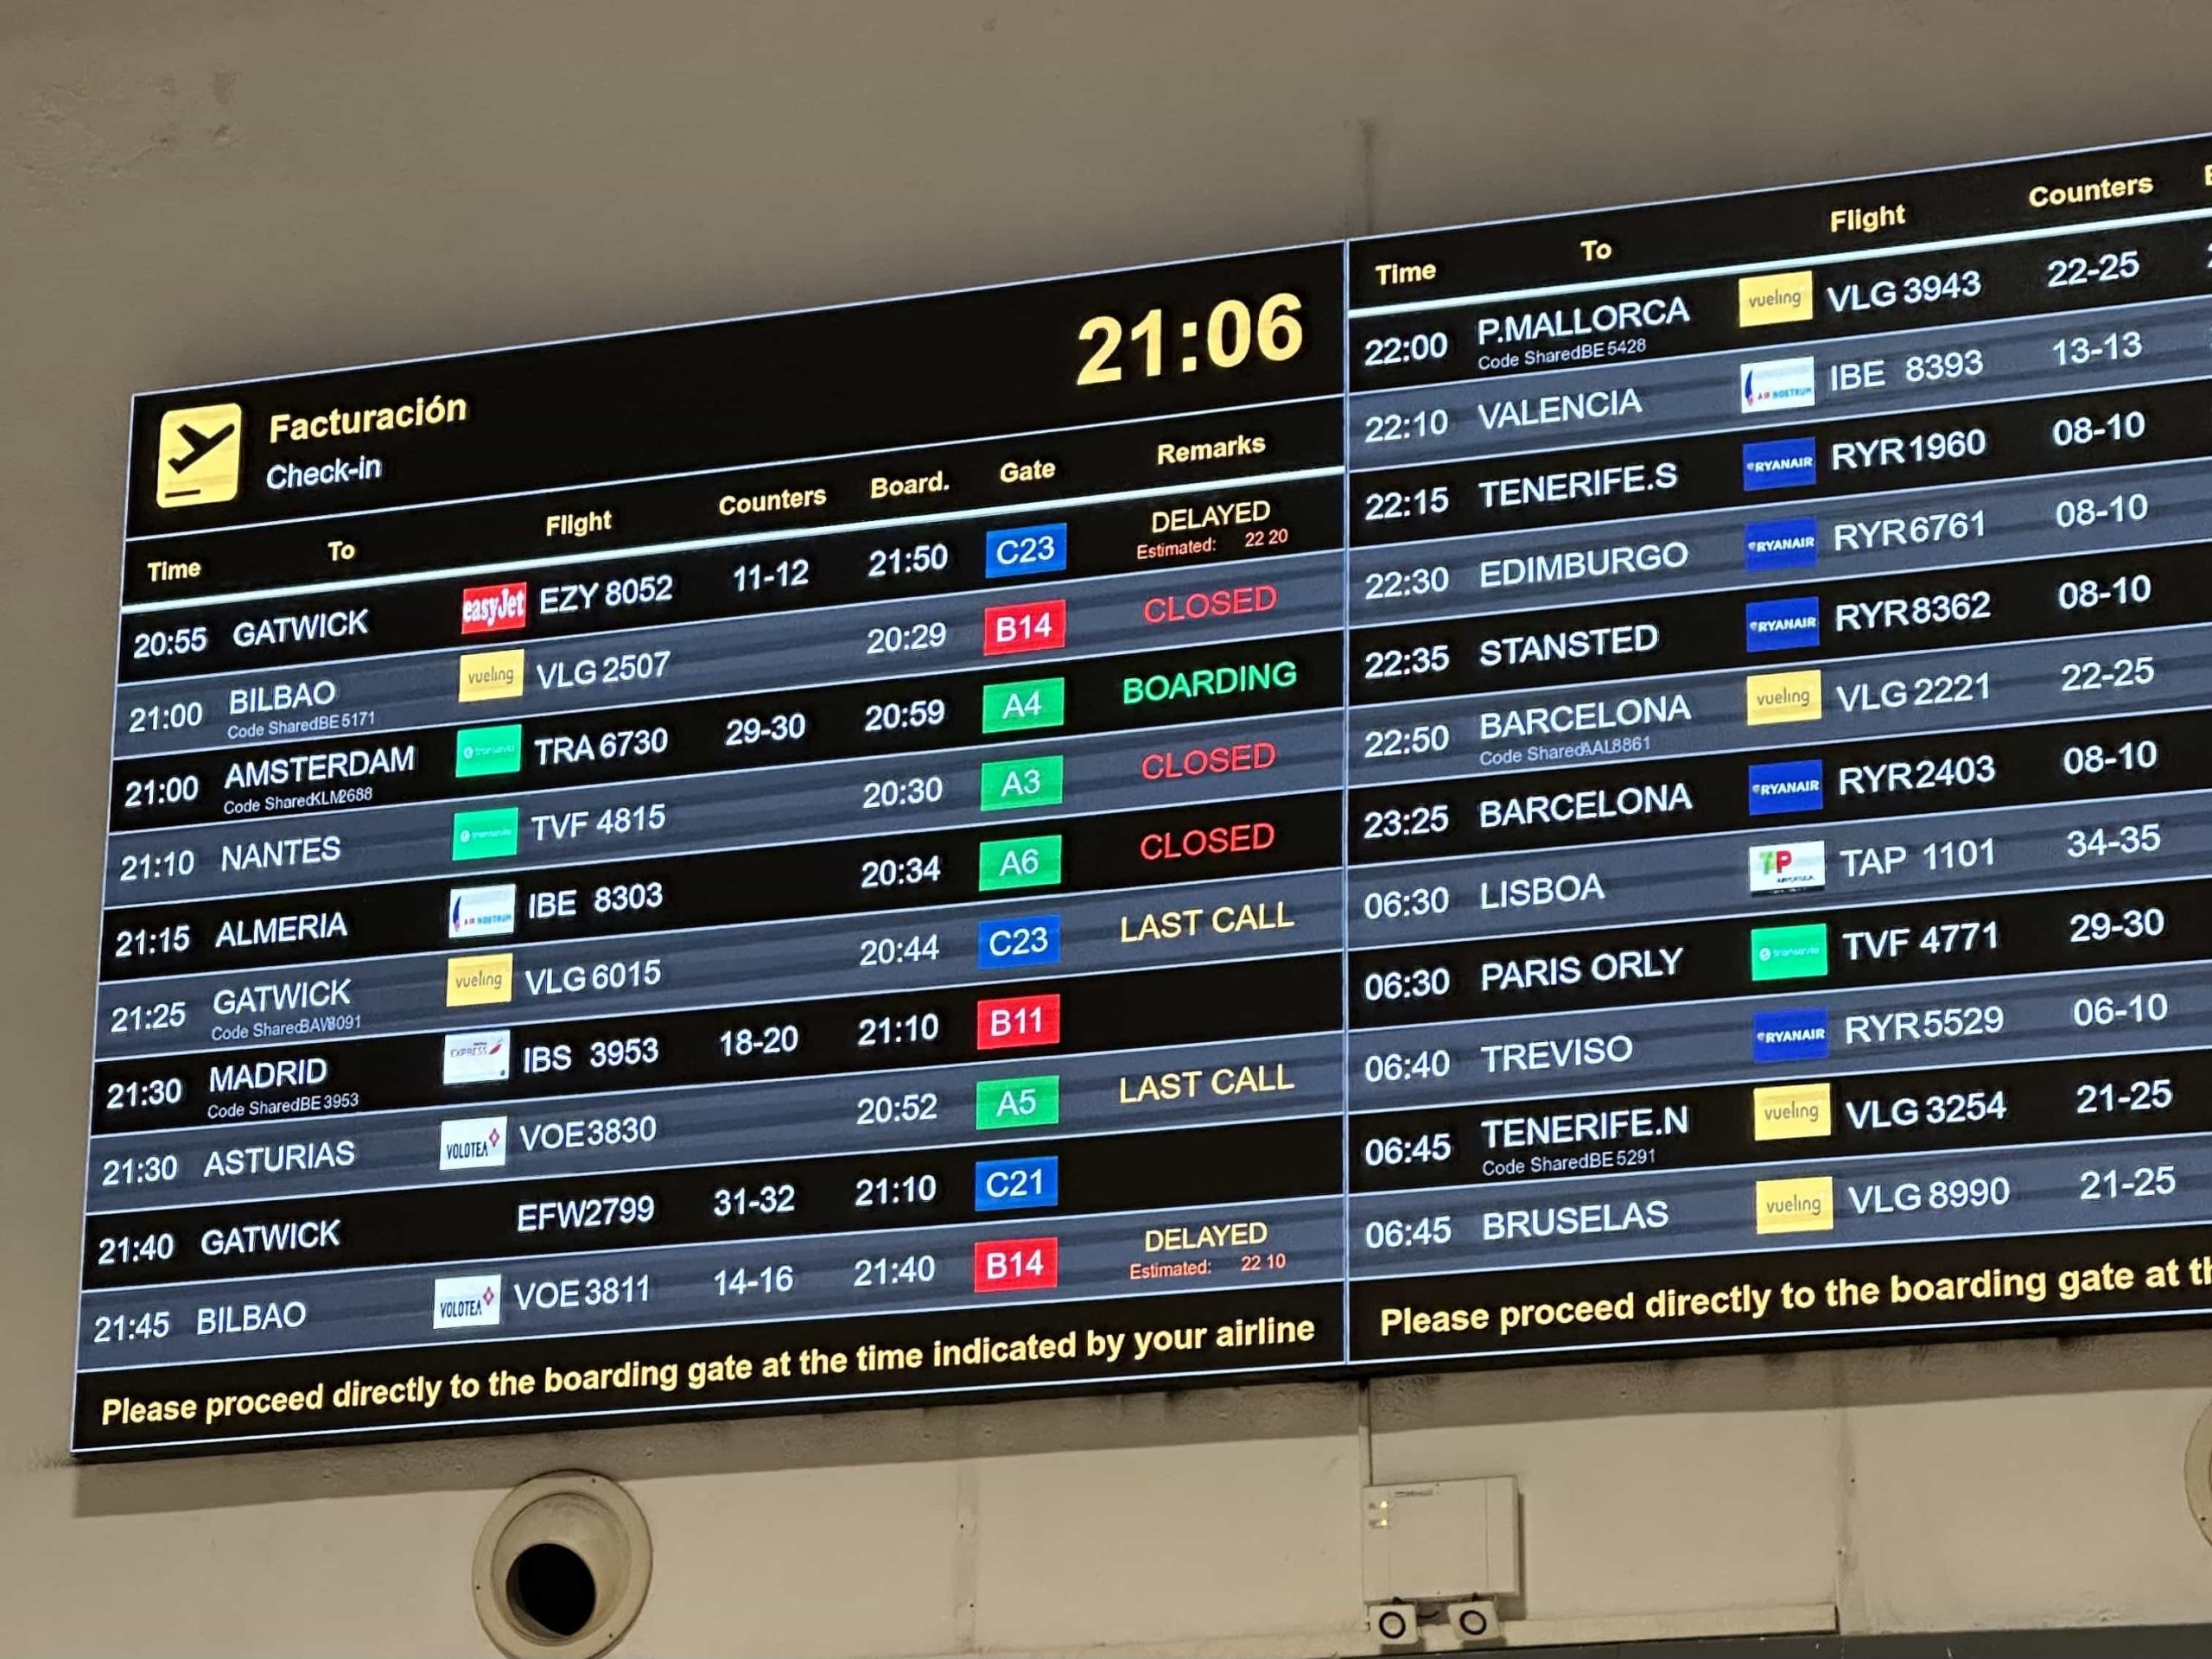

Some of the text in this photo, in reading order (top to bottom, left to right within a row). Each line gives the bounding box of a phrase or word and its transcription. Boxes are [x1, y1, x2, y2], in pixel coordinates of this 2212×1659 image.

[2029, 177, 2153, 207] Counters
[1831, 204, 1905, 232] Flight
[1580, 240, 1611, 261] To
[1375, 264, 1436, 285] Time
[2048, 251, 2139, 288] 22-25
[1749, 289, 1801, 308] vueling
[1478, 296, 1690, 345] P.MALLORCA
[1076, 293, 1302, 385] 21:06
[1364, 332, 1447, 366] 22:00
[2053, 331, 2142, 365] 13-13
[1831, 349, 1983, 391] IBE 8393
[270, 395, 467, 443] Facturación
[1478, 388, 1643, 429] VALENCIA
[1365, 410, 1448, 442] 22:10
[2052, 411, 2145, 446] 08-10
[1158, 435, 1266, 465] Remarks
[1755, 457, 1813, 472] RYANAIR
[266, 455, 382, 490] Check-in
[871, 470, 950, 499] Board.
[1000, 460, 1056, 483] Gate
[1478, 462, 1677, 507] TENERIFE.S
[719, 489, 827, 515] Counters
[1153, 500, 1274, 537] DELAYED
[1365, 486, 1448, 521] 22:15
[547, 510, 612, 537] Flight
[327, 541, 355, 561] To
[868, 543, 948, 577] 21:50
[997, 536, 1054, 564] C23
[1137, 537, 1216, 559] Estimated:
[147, 561, 201, 582] Time
[734, 559, 809, 592] 11-12
[1481, 542, 1688, 588] EDIMBURGO
[540, 575, 672, 615] EZY 8052
[1365, 567, 1448, 600] 22:30
[463, 588, 525, 626] easyJet
[1145, 586, 1276, 622] CLOSED
[134, 626, 208, 659] 20:55
[233, 608, 368, 647] GATWICK
[867, 622, 946, 654] 20:29
[997, 613, 1052, 642] B14
[1479, 624, 1660, 666] STANSTED
[469, 666, 513, 684] vueling
[1364, 645, 1449, 679] 22:35
[230, 680, 336, 715] BILBAO
[1124, 661, 1297, 704] BOARDING
[130, 702, 202, 733] 21:00
[865, 699, 945, 732] 20:59
[1002, 691, 1041, 718] A4
[1481, 695, 1692, 739] BARCELONA
[228, 723, 264, 739] Code
[724, 713, 805, 746] 29-30
[1365, 725, 1449, 758] 22:50
[224, 745, 416, 789] AMSTERDAM
[1142, 743, 1275, 779] CLOSED
[124, 775, 198, 808] 21:00
[863, 775, 943, 808] 20:30
[1001, 769, 1040, 797] A3
[1363, 804, 1448, 839] 23:25
[1480, 783, 1693, 828] BARCELONA
[531, 811, 588, 841] TVF
[596, 804, 665, 834] 4815
[222, 836, 340, 871] NANTES
[1141, 823, 1274, 860] CLOSED
[2068, 823, 2160, 857] 34-35
[120, 850, 194, 880] 21:10
[861, 855, 941, 888] 20:34
[1000, 849, 1038, 875] A6
[1840, 838, 1993, 876] TAP 1101
[529, 882, 663, 918] IBE 8303
[1363, 887, 1449, 918] 06:30
[1480, 874, 1605, 909] LISBOA
[215, 912, 347, 948] ALMERIA
[1122, 901, 1294, 942] LAST CALL
[2070, 907, 2164, 942] 29-30
[115, 925, 190, 958] 21:15
[861, 934, 939, 965] 20:44
[990, 927, 1048, 956] C23
[1842, 928, 1911, 960] TVF
[1919, 921, 1998, 954] 4771
[456, 970, 502, 989] vueling
[1364, 968, 1450, 1001] 06:30
[1482, 947, 1683, 991] PARIS ORLY
[213, 978, 351, 1014] GATWICK
[2075, 994, 2167, 1026] 06-10
[111, 1001, 186, 1033] 21:25
[857, 1013, 938, 1046] 21:10
[991, 1007, 1040, 1036] B11
[721, 1025, 798, 1057] 18-20
[1766, 1028, 1825, 1043] RYANAIR
[524, 1037, 658, 1073] IBS 3953
[1365, 1050, 1450, 1082] 06:40
[1481, 1035, 1632, 1072] TREVISO
[210, 1058, 327, 1092] MADRID
[1121, 1064, 1294, 1103] LAST CALL
[106, 1077, 182, 1109] 21:30
[857, 1093, 937, 1124] 20:52
[996, 1089, 1036, 1116] A5
[1481, 1105, 1688, 1148] TENERIFE.N
[204, 1141, 354, 1177] ASTURIAS
[447, 1141, 488, 1159] VOLOTEA
[1365, 1133, 1451, 1166] 06:45
[103, 1155, 177, 1186] 21:30
[987, 1169, 1041, 1198] C21
[2081, 1166, 2176, 1199] 21-25
[714, 1185, 795, 1217] 31-32
[855, 1175, 936, 1207] 21:10
[518, 1195, 654, 1232] EFW2799
[1484, 1200, 1669, 1240] BRUSELAS
[201, 1219, 340, 1255] GATWICK
[1146, 1222, 1267, 1252] DELAYED
[1366, 1216, 1451, 1248] 06:45
[99, 1233, 175, 1265] 21:40
[988, 1249, 1043, 1279] B14
[715, 1265, 793, 1295] 14-16
[855, 1255, 935, 1287] 21:40
[1130, 1259, 1211, 1280] Estimated:
[441, 1300, 481, 1318] VOLOTEA
[1382, 1262, 2134, 1336] Please proceed directly to the boarding gate
[94, 1312, 169, 1342] 21:45
[197, 1301, 306, 1335] BILBAO
[102, 1317, 1314, 1425] Please proceed directly to the boarding gate at the time indicated by your airline
